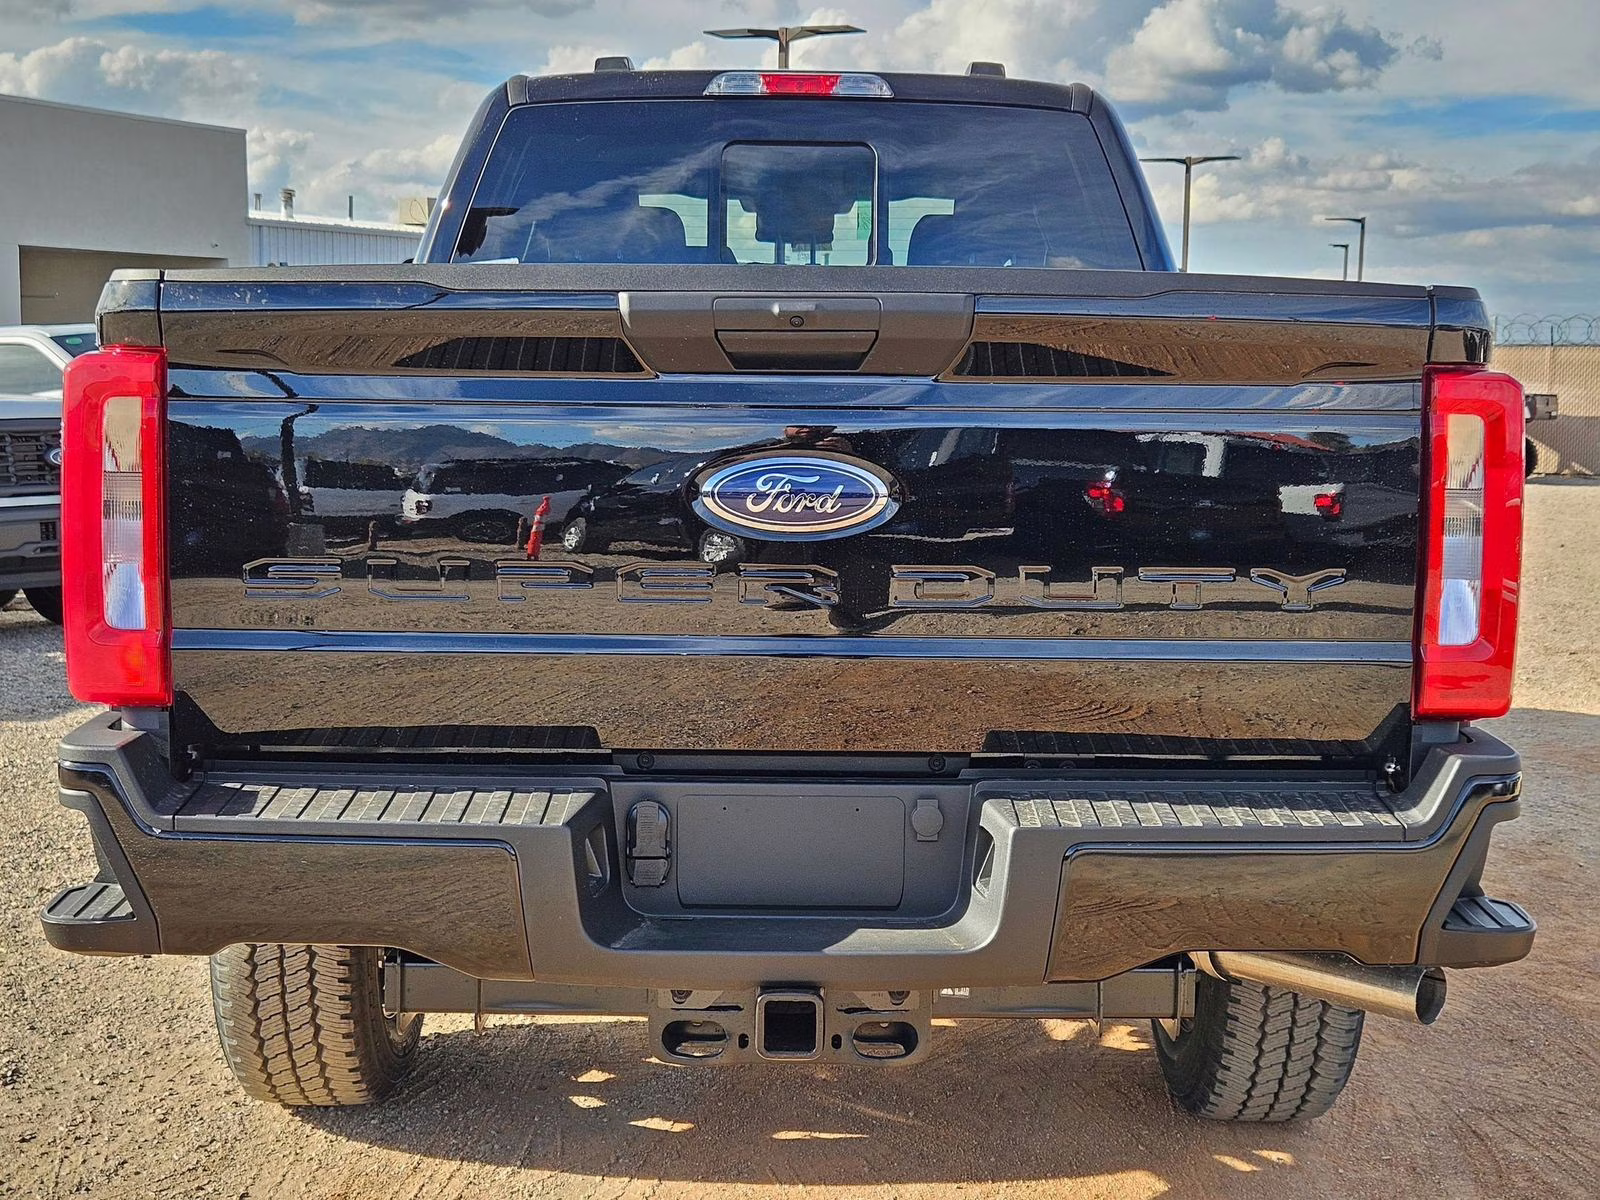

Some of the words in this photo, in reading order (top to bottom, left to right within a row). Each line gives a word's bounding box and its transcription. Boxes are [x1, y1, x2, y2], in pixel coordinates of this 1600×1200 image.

[746, 473, 844, 514] Ford
[242, 557, 839, 606] SUPER
[888, 564, 1347, 610] DUTY
